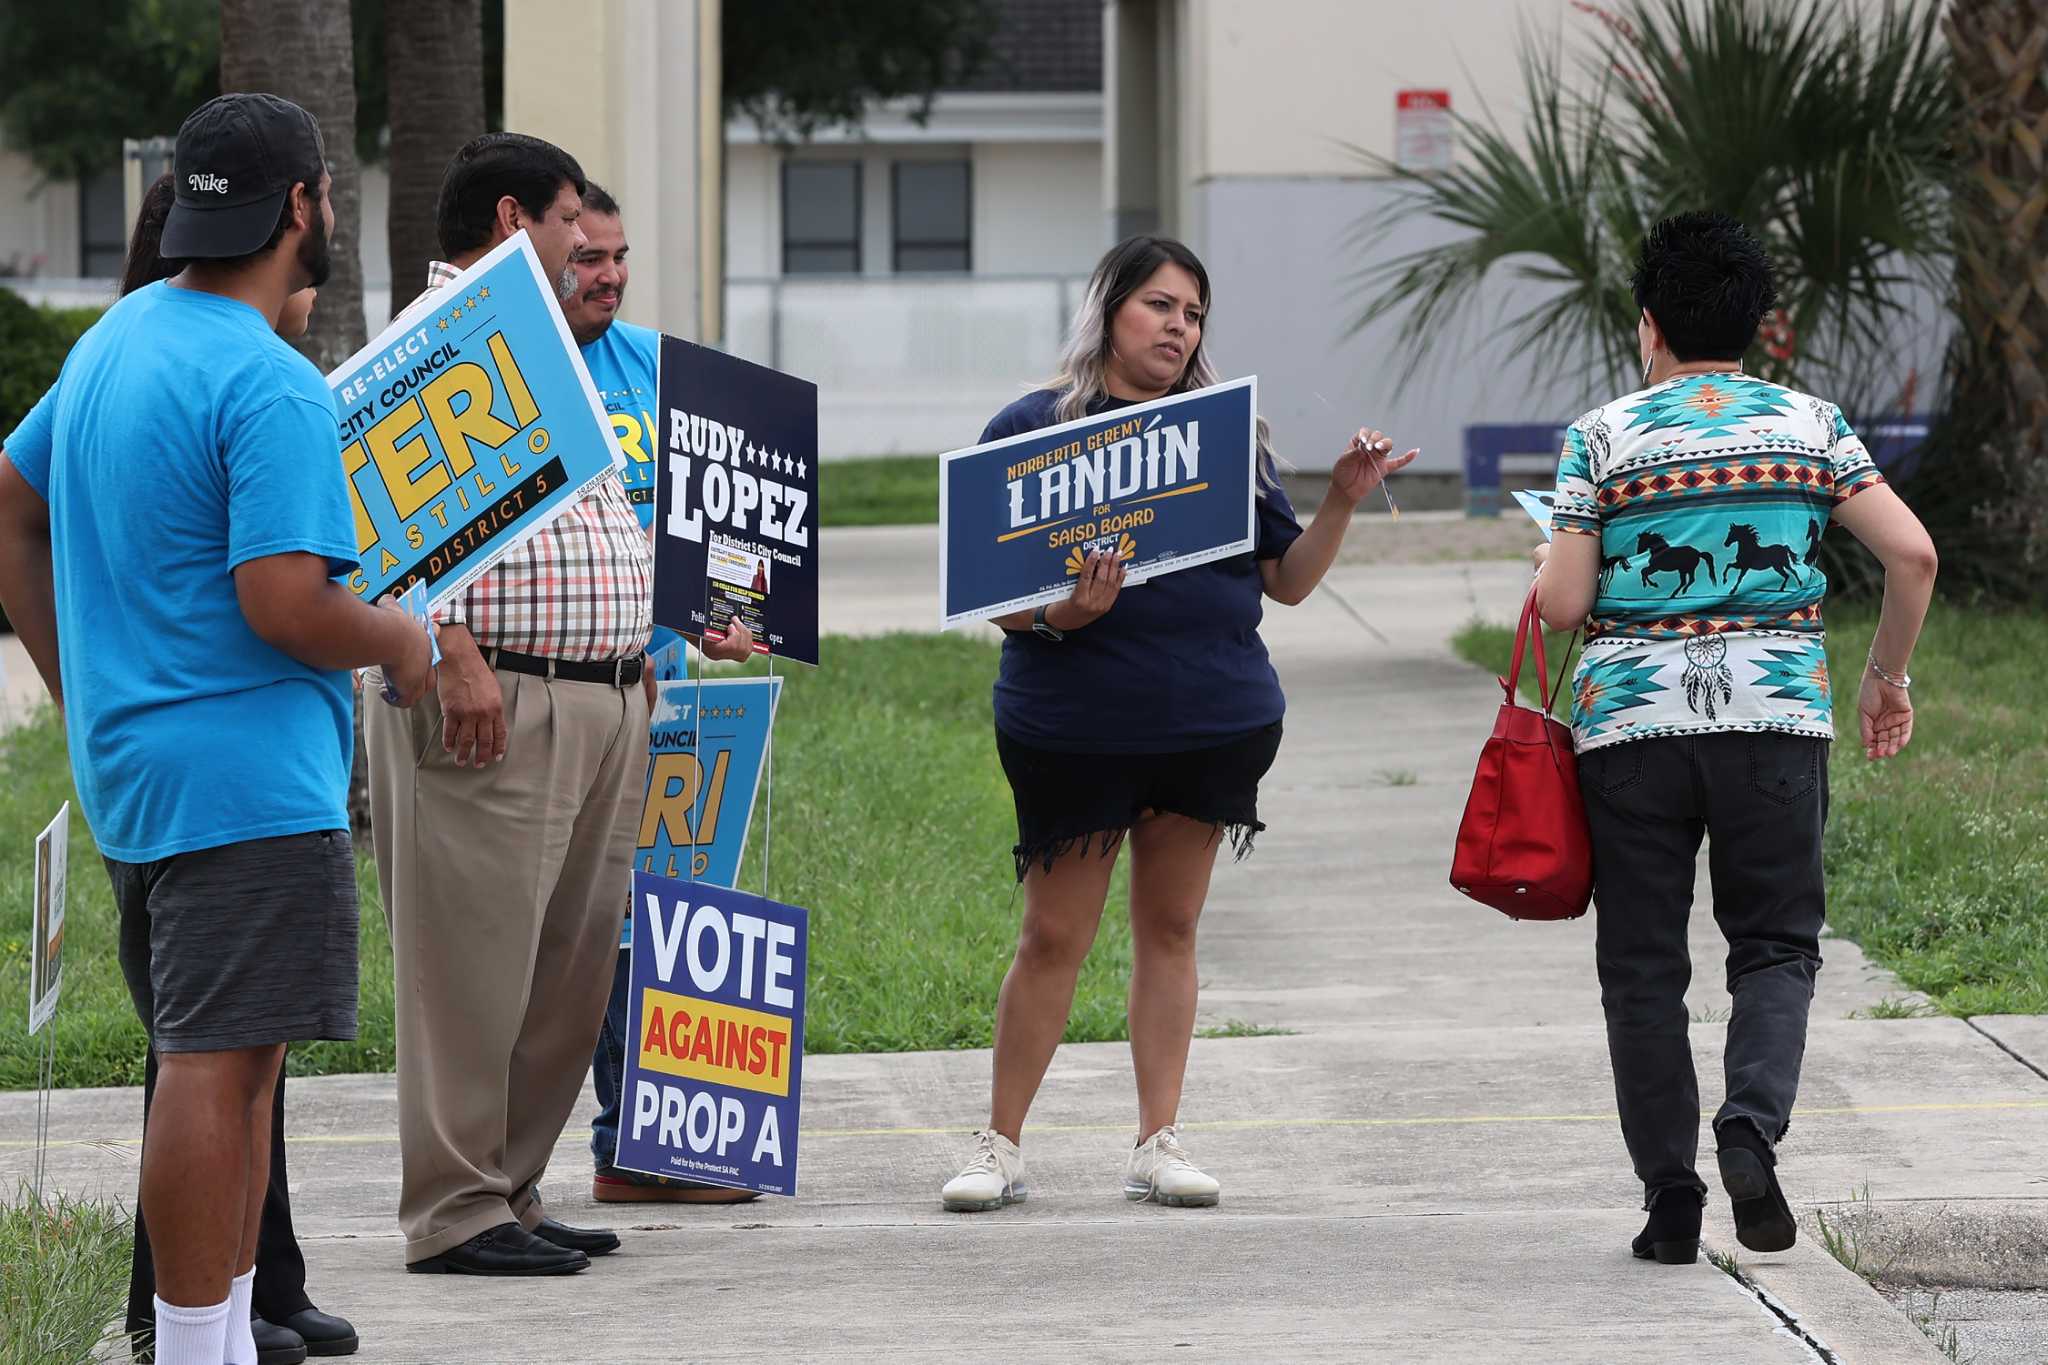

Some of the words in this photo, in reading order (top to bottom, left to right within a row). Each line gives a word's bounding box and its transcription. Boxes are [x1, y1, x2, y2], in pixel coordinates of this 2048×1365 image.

[189, 173, 228, 194] Nike
[339, 401, 376, 442] CITY
[381, 342, 460, 407] COUNCIL
[340, 329, 430, 405] RE-ELECT
[669, 408, 744, 468] RUDY
[1006, 440, 1081, 481] NORBERTO
[1087, 417, 1143, 450] GEREMY
[1007, 414, 1200, 528] LANDÍN
[347, 427, 550, 596] CASTILLO
[430, 495, 525, 573] DISTRICT
[537, 475, 548, 493] 5
[667, 452, 808, 548] LOPEZ
[1048, 523, 1096, 548] SAISD
[1101, 507, 1154, 535] BOARD
[1093, 504, 1111, 517] FOR
[723, 534, 751, 552] District
[751, 542, 757, 554] 5
[758, 543, 771, 559] City
[773, 549, 801, 567] Council
[1083, 533, 1120, 551] DISTRICT
[646, 893, 795, 1009] VOTE
[643, 1006, 787, 1078] AGAINST
[632, 1079, 745, 1156] PROP
[751, 1105, 783, 1167] A
[671, 1156, 681, 1166] Paid
[695, 1161, 704, 1170] the
